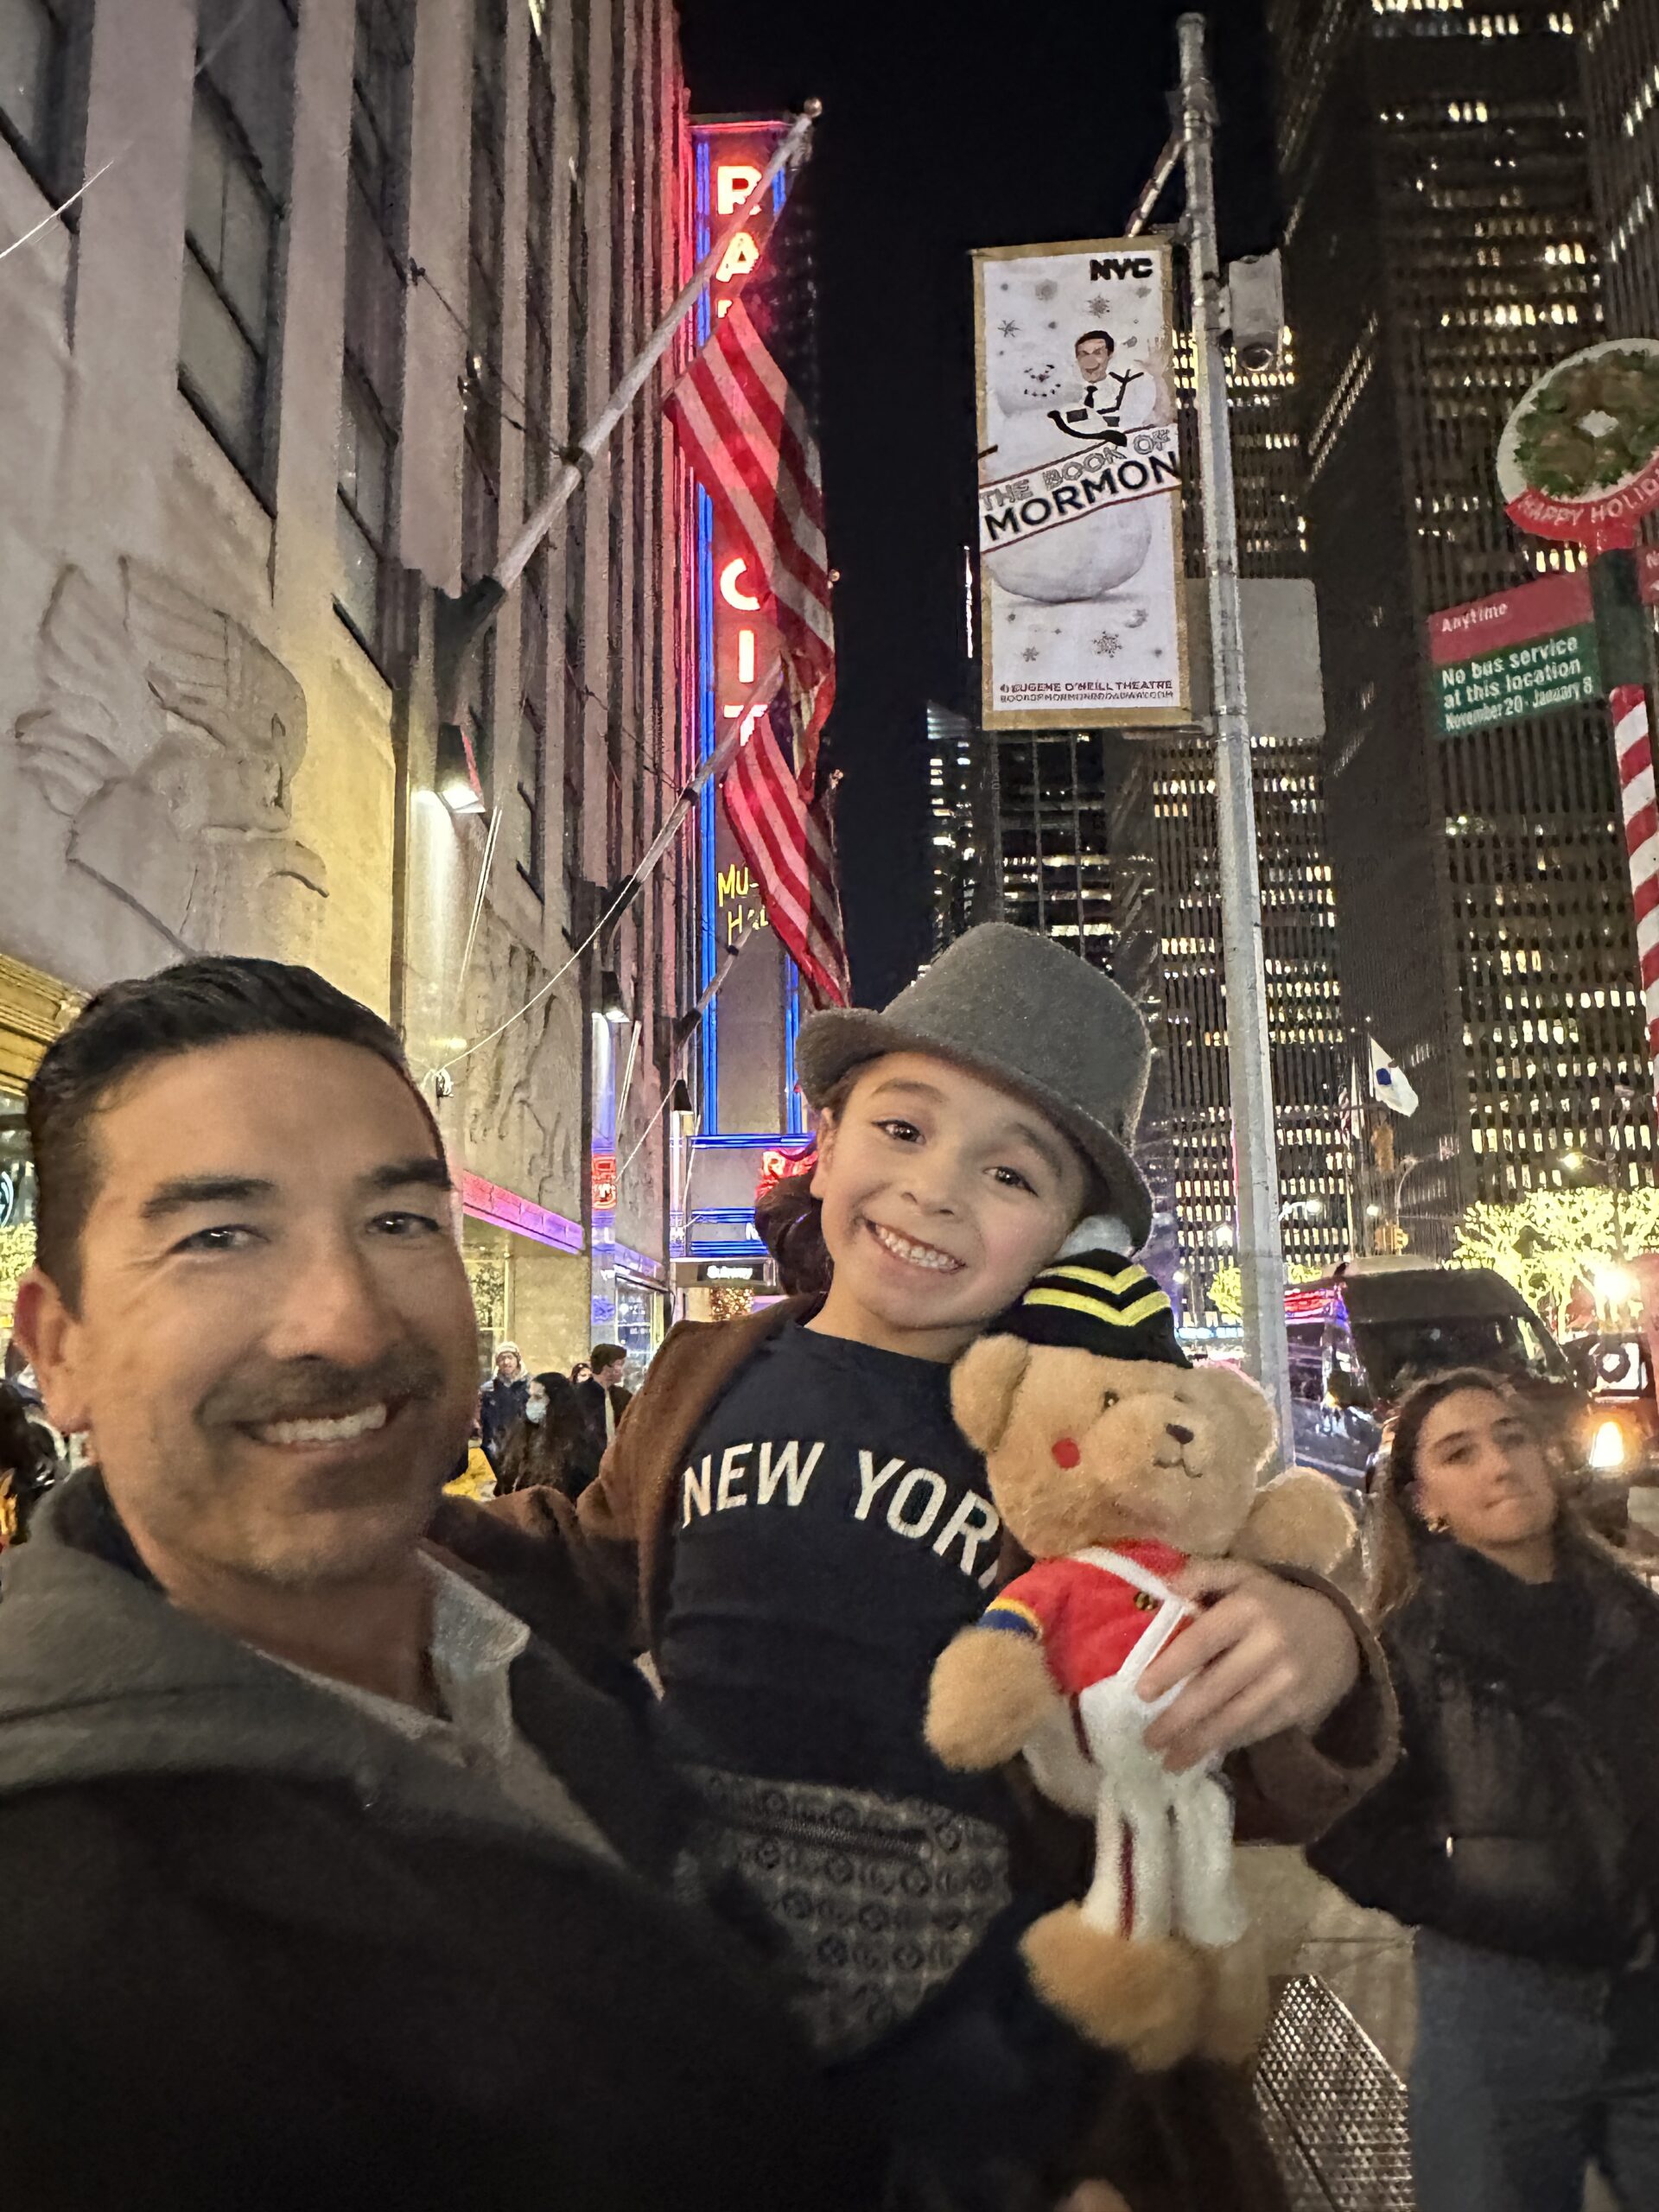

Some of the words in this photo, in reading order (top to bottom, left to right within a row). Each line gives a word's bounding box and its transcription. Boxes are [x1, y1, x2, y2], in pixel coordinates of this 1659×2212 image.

[1090, 258, 1153, 281] NYC
[980, 479, 1033, 511] THE
[1041, 446, 1127, 491] BOOK
[1133, 429, 1170, 455] OF
[984, 451, 1180, 541] MORMON
[1517, 494, 1585, 526] HAPPY
[1441, 603, 1509, 632] Anytime
[1115, 681, 1173, 691] THEATRE
[1441, 667, 1466, 690] No
[1471, 657, 1504, 679] bus
[1509, 636, 1579, 669] service
[1444, 690, 1462, 709] at
[1465, 679, 1501, 703] this
[1505, 658, 1581, 693] location
[1445, 702, 1503, 732] November
[1503, 694, 1523, 716] 20
[1532, 681, 1580, 709] January
[1582, 676, 1593, 694] 8
[683, 1440, 825, 1529] NEW
[854, 1449, 1001, 1590] YOR
